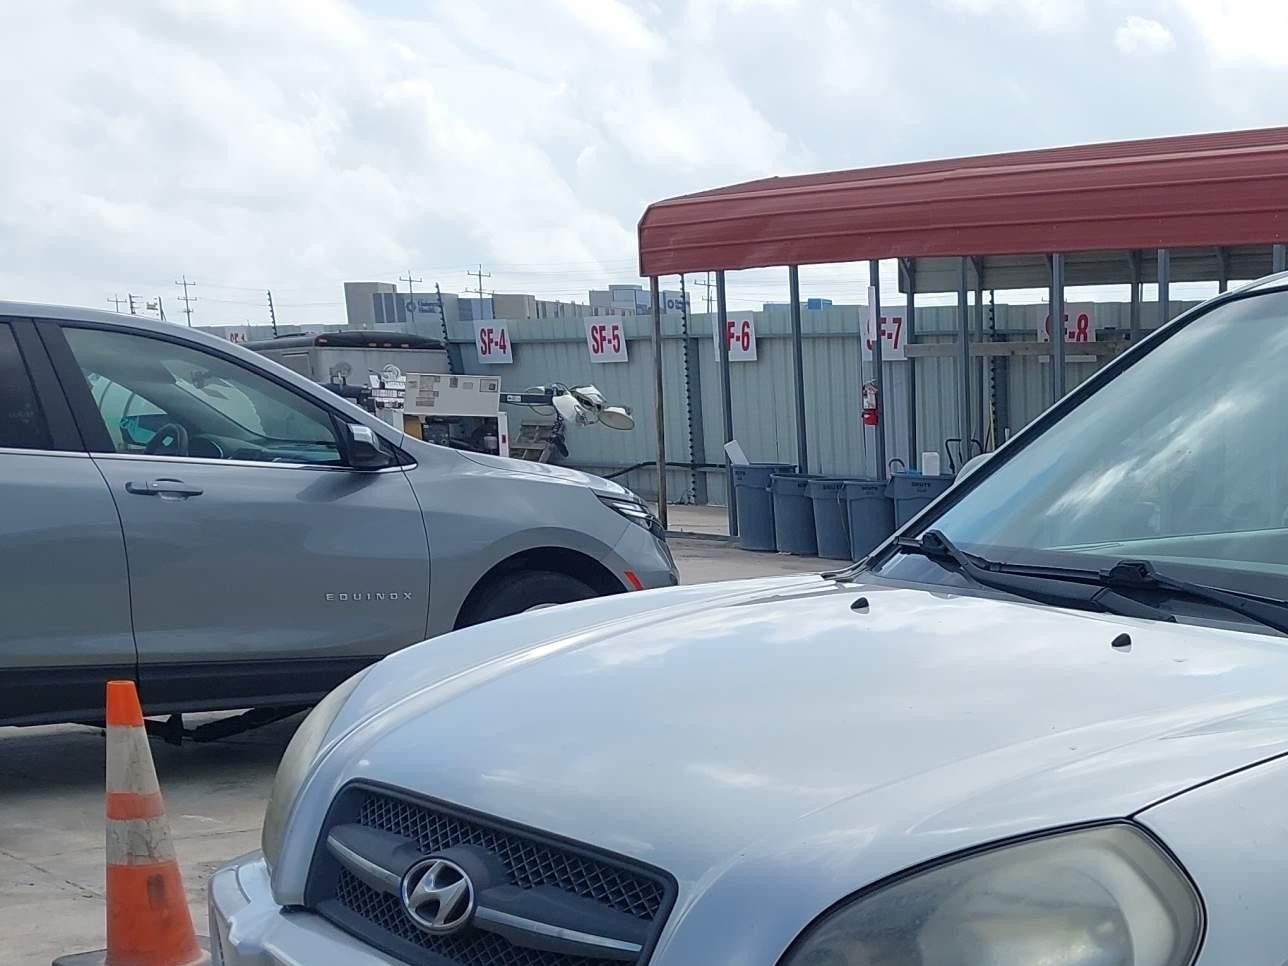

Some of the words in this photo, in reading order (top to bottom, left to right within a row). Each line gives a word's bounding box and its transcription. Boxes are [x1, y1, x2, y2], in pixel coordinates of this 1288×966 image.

[479, 328, 508, 355] SF-4
[591, 324, 621, 354] SF-5
[726, 320, 751, 351] F-6
[866, 317, 902, 350] F-7
[326, 592, 412, 601] EQUINOX
